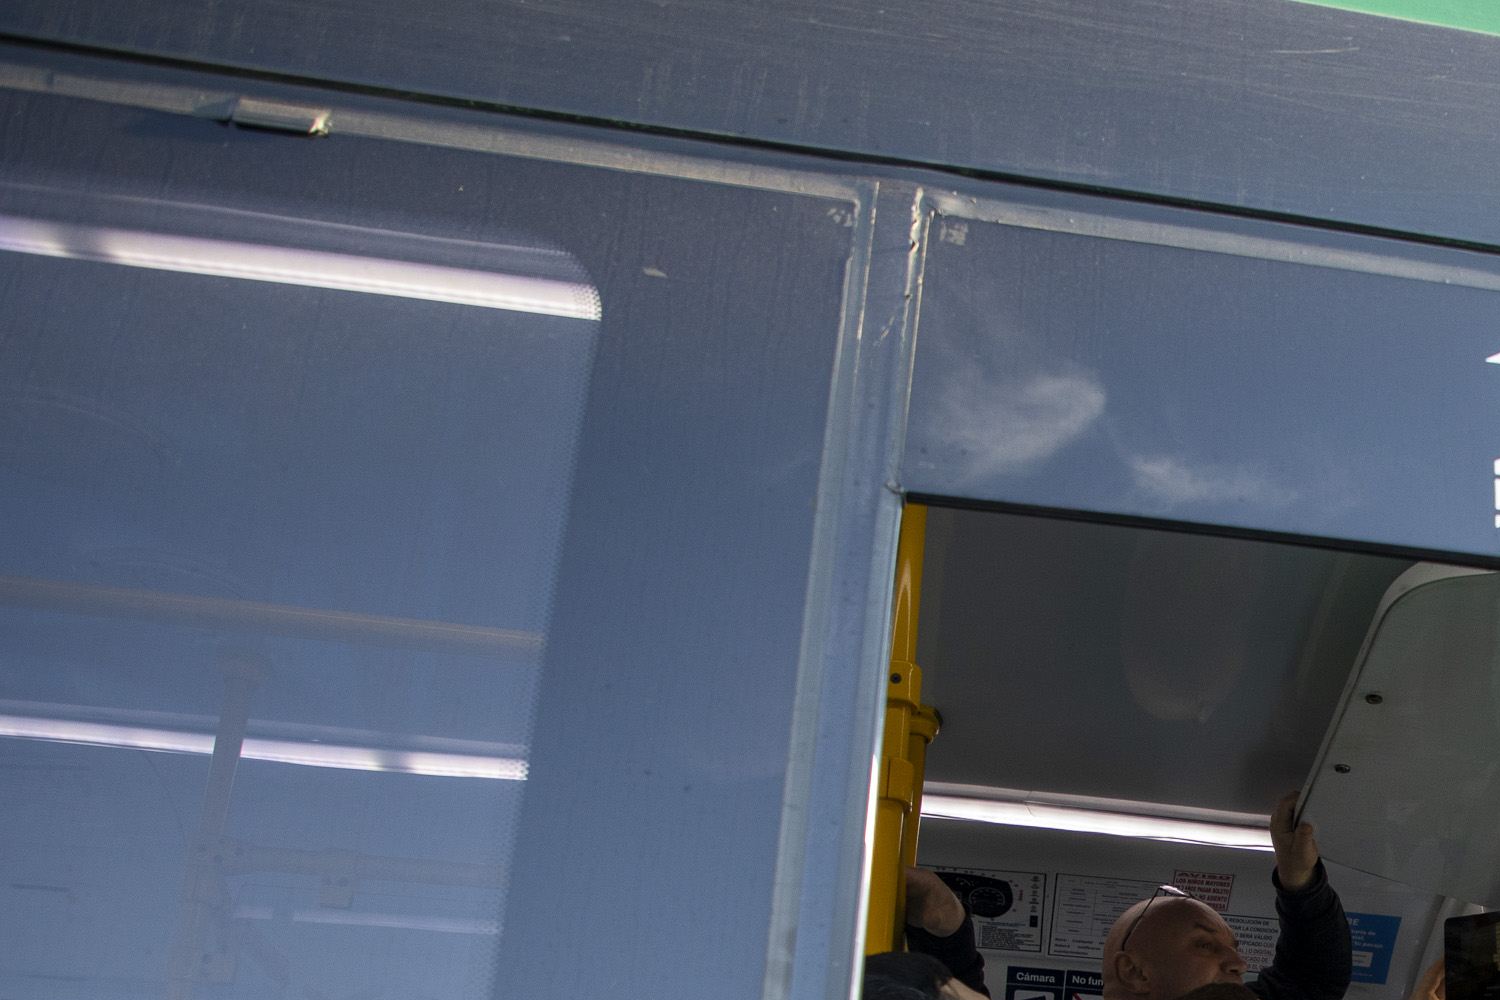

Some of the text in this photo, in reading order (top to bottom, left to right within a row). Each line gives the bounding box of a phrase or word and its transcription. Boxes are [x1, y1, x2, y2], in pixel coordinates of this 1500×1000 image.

[1177, 872, 1231, 880] AVISO
[1016, 971, 1056, 983] Cámara
[1072, 975, 1086, 985] No
